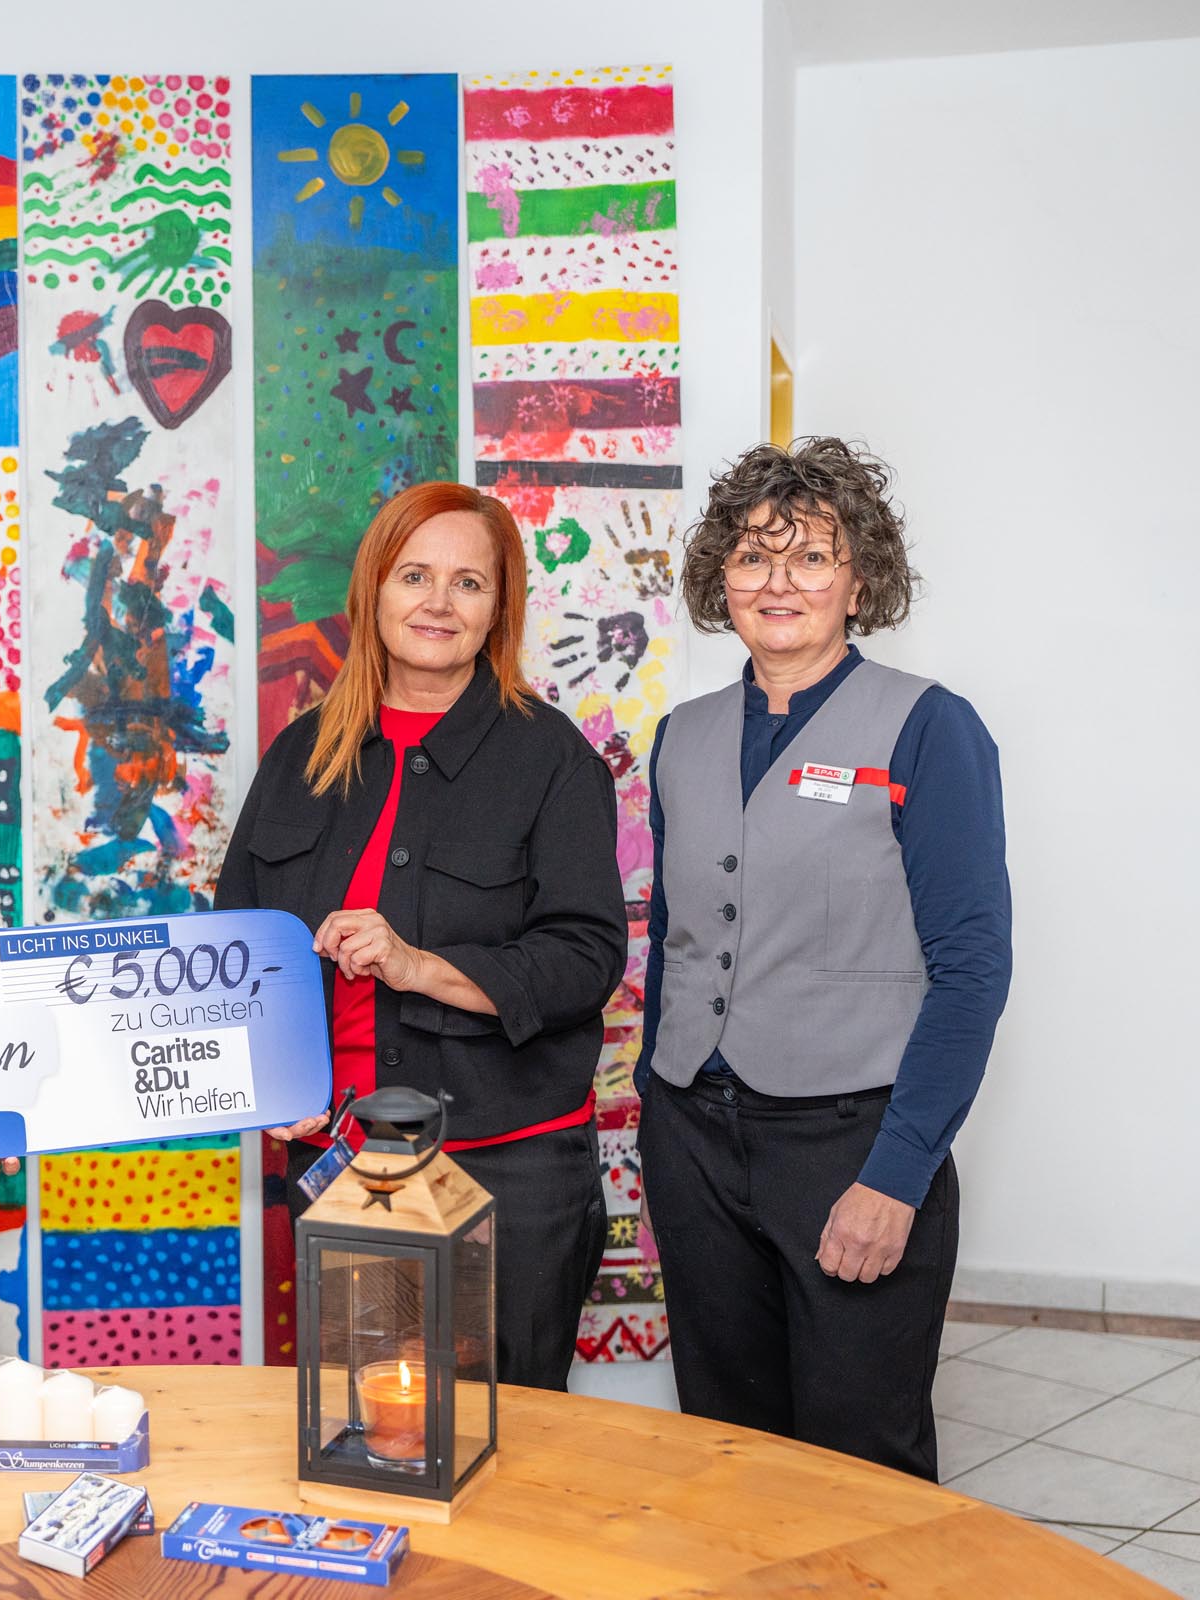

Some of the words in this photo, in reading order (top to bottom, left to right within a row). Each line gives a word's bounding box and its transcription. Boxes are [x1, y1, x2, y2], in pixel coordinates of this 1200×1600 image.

[813, 768, 841, 777] SPAR
[7, 937, 56, 954] LICHT
[62, 934, 90, 950] INS
[95, 929, 164, 948] DUNKEL
[55, 954, 99, 1005] €
[111, 1011, 143, 1032] zu
[150, 999, 264, 1028] Gunsten
[130, 1037, 221, 1067] Caritas
[134, 1066, 190, 1094] &Du
[136, 1093, 175, 1119] Wir
[179, 1087, 251, 1115] helfen.
